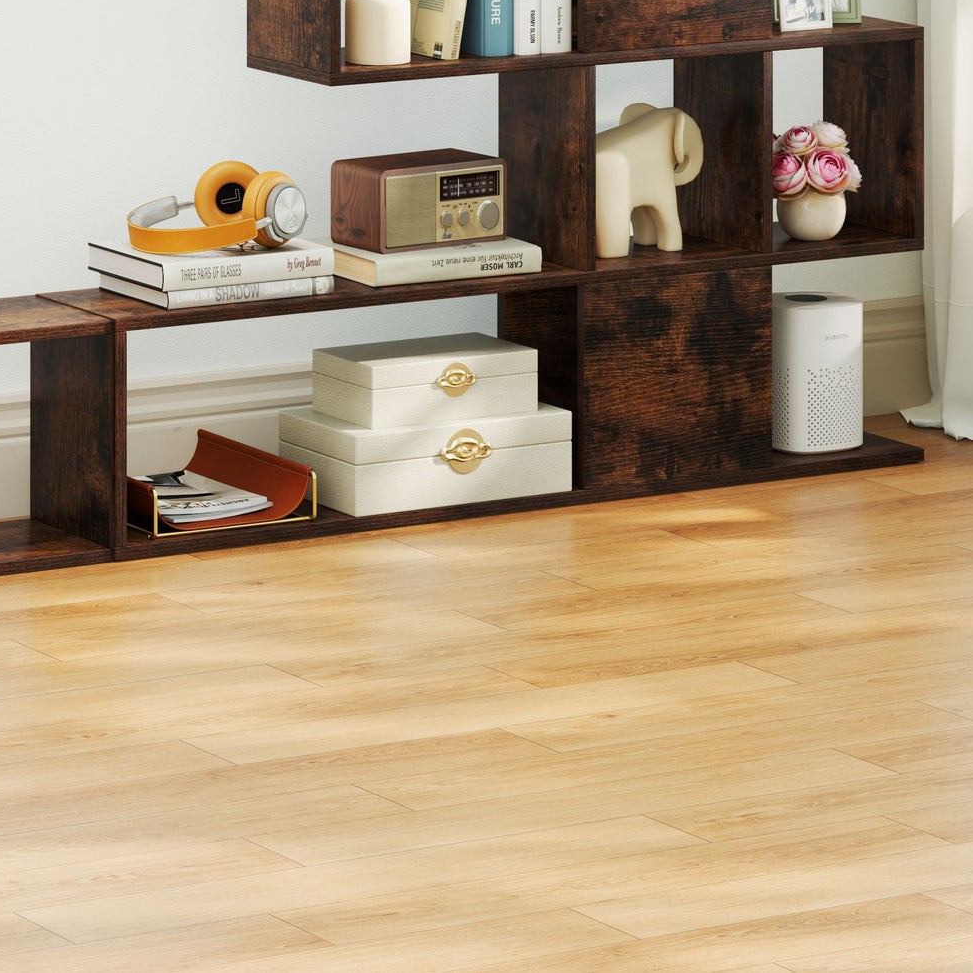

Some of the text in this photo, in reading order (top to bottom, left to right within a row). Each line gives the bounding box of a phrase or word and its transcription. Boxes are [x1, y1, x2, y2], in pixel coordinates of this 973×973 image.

[445, 257, 461, 265] neue
[478, 255, 487, 263] für
[489, 253, 523, 261] Architektur
[431, 259, 444, 267] Zeit
[480, 260, 523, 271] CARL MOSER
[181, 268, 196, 281] THREE
[197, 267, 211, 280] PAIRS
[213, 266, 219, 277] OF
[220, 263, 242, 277] GLASSES
[287, 259, 293, 273] by
[215, 282, 260, 303] SHADOW
[825, 333, 849, 341] xiaomi
